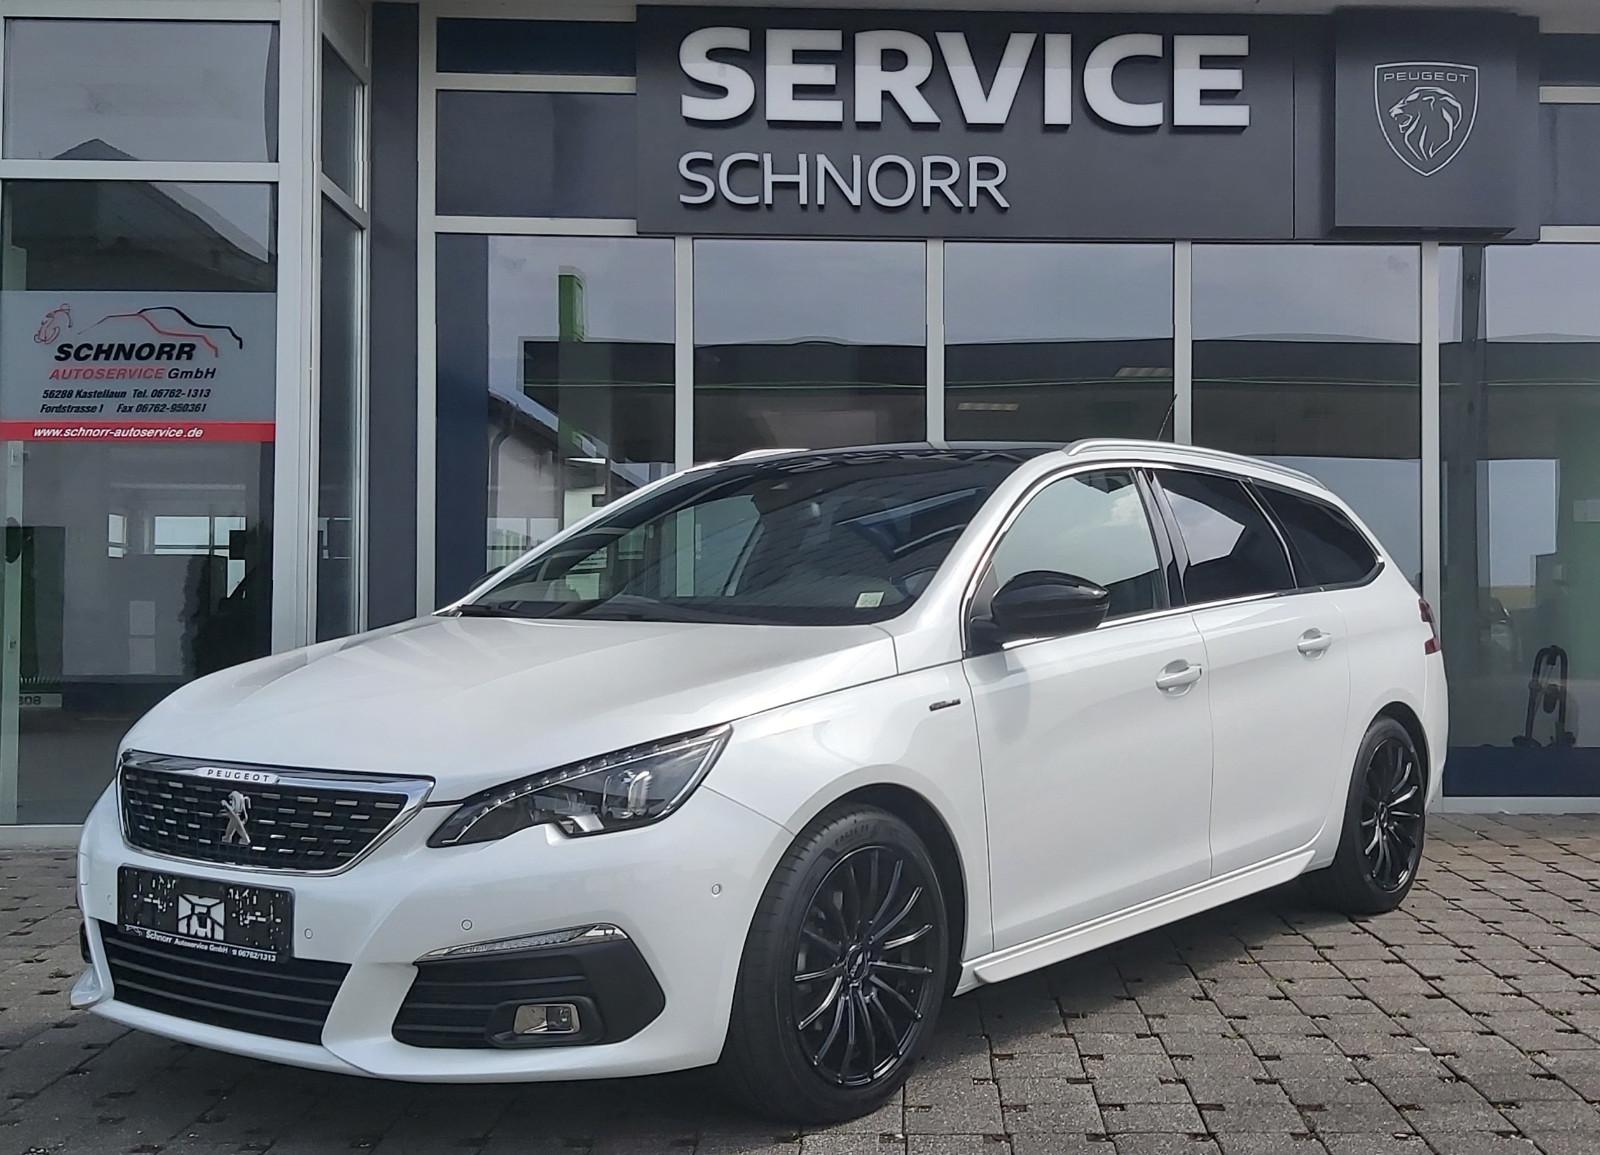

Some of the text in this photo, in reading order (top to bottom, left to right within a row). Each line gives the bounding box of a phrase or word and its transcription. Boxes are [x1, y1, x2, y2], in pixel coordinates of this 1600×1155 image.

[678, 26, 1250, 128] SERVICE
[1383, 71, 1470, 83] PEUGEOT
[677, 151, 1010, 210] SCHNORR
[54, 343, 196, 361] SCHNORR
[49, 367, 217, 380] AUTOSERVICE GmbH
[42, 388, 212, 399] 56288 Kastellaun Tel. 06762-1313
[116, 403, 134, 413] Fax
[135, 403, 208, 413] 06762-950361
[33, 426, 204, 438] www.schnorr-autoservice.de
[206, 768, 271, 782] PEUGEOT
[146, 929, 172, 944] Schnorr
